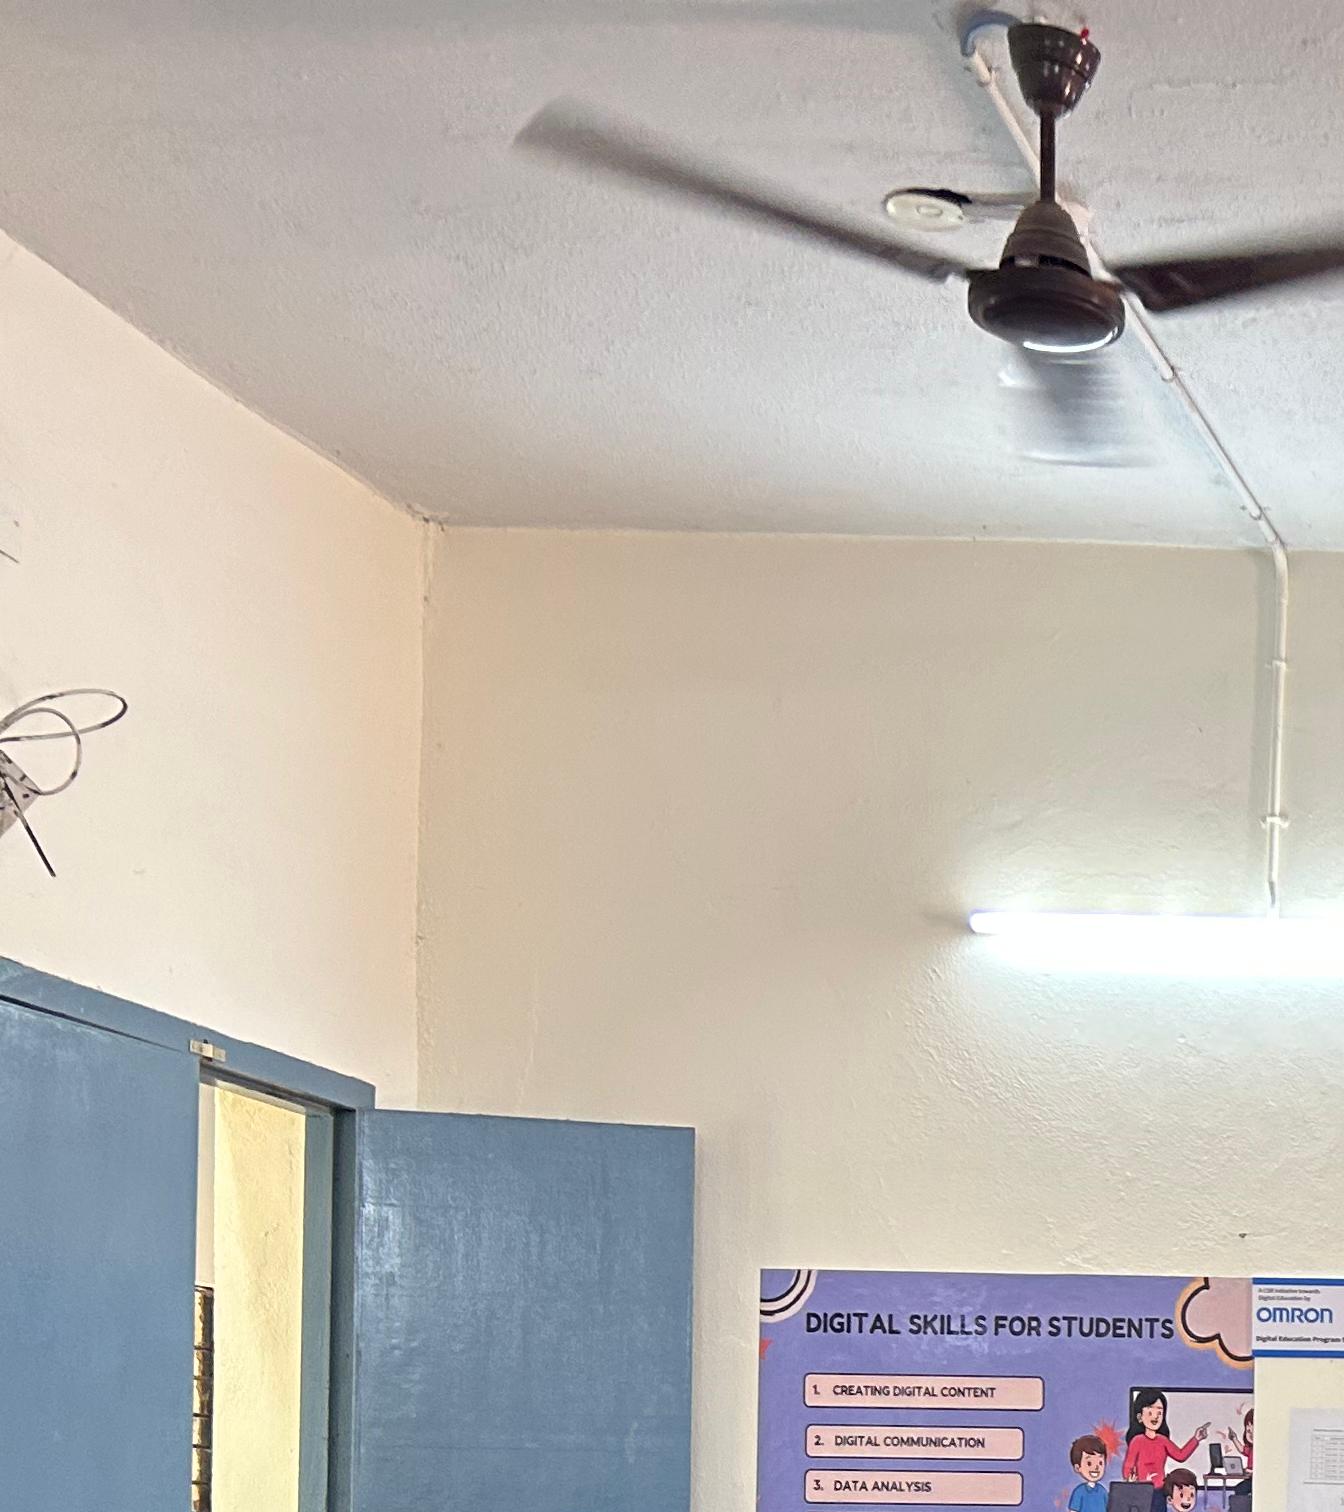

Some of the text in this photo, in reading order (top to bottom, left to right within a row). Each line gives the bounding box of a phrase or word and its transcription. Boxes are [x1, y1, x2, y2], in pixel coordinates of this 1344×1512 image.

[805, 1312, 1175, 1339] DIGITAL SKILLS FOR STUDENTS
[1256, 1335, 1278, 1343] Digital
[1313, 1336, 1341, 1344] Program
[813, 1384, 997, 1399] 1. CREATING DIGITAL CONTENT
[814, 1435, 986, 1448] 2. DIGITAL COMMUNICATION
[813, 1479, 932, 1493] 3. DATA ANALYSIS
